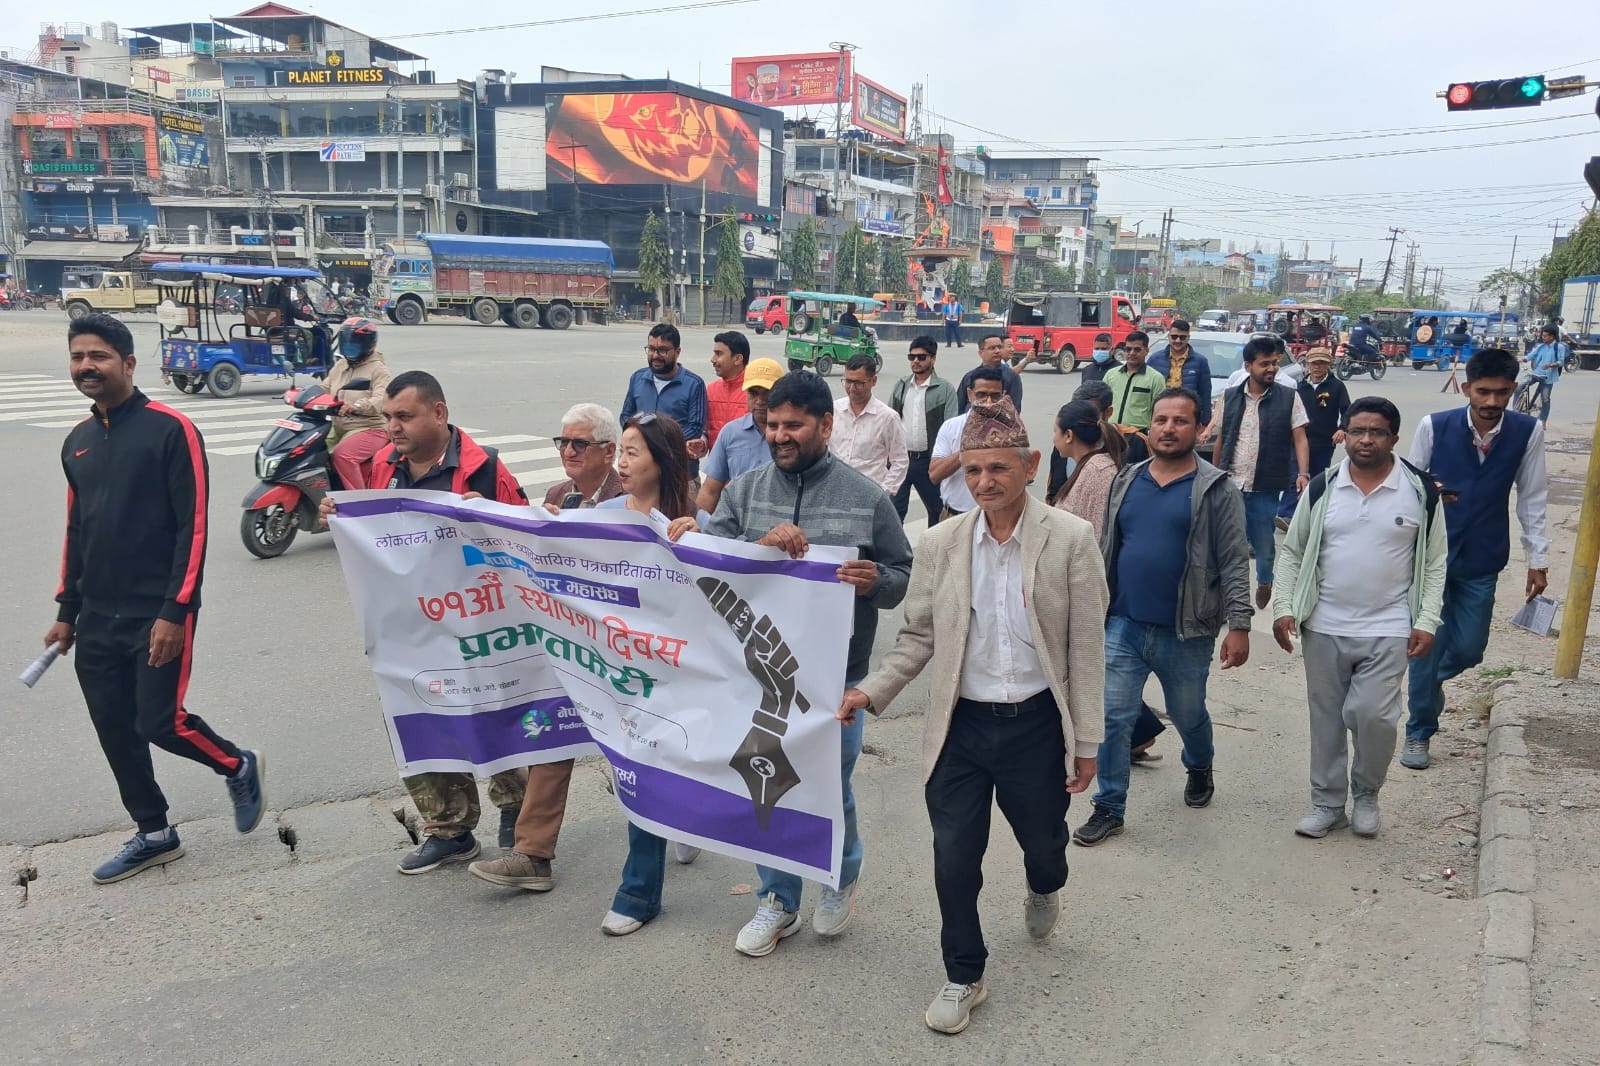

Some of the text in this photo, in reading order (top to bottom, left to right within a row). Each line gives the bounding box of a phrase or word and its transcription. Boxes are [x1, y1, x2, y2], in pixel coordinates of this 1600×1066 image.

[288, 69, 384, 84] PLANET FITNESS
[186, 87, 211, 98] OASIS
[32, 163, 96, 173] OASIS FITNESS
[375, 531, 432, 548] लोकतन्त्र,
[434, 525, 458, 541] प्रेस
[579, 558, 662, 582] पत्रकारिताको
[566, 580, 620, 602] महासंघ
[514, 585, 597, 640] स्थापना
[602, 615, 689, 668] दिवस
[731, 606, 750, 631] RESS
[454, 622, 658, 699] प्रभातफेरी
